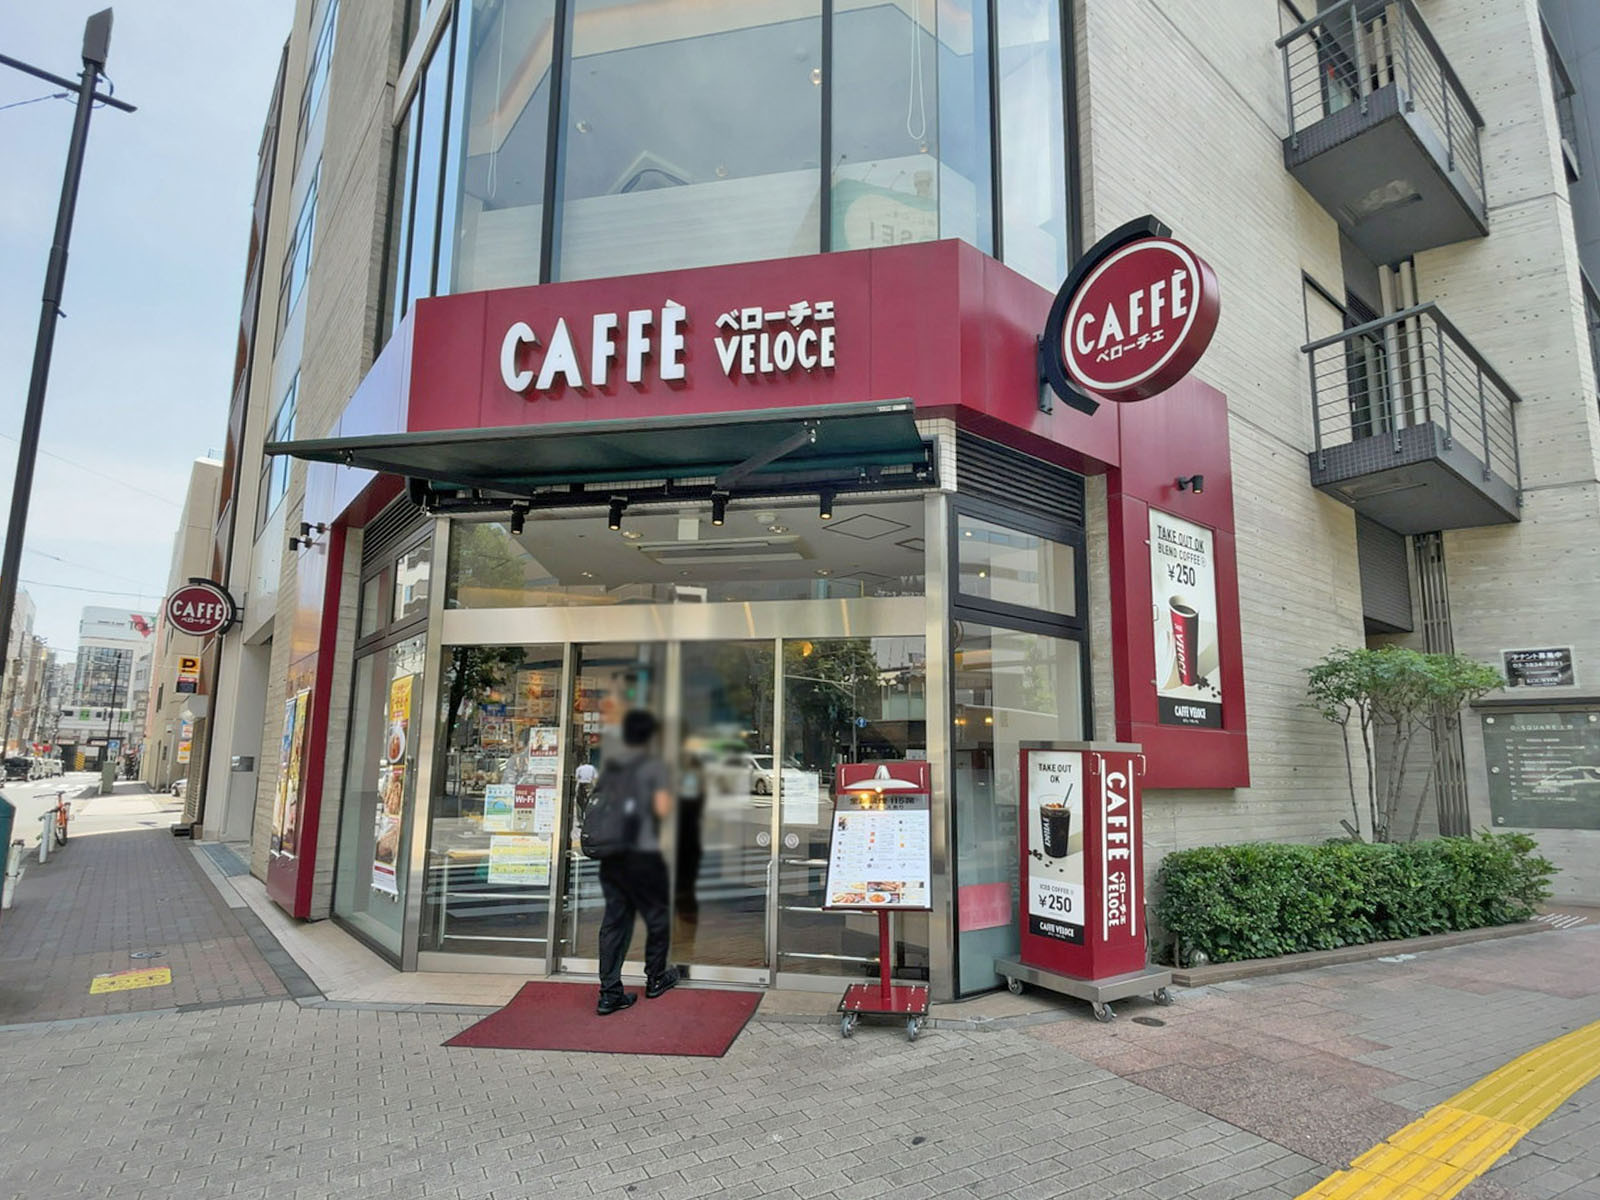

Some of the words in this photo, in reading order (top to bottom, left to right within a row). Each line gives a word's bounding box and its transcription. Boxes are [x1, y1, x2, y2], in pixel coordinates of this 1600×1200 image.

[714, 301, 835, 330] ベローチェ
[1076, 269, 1187, 355] CAFFÈ
[500, 299, 686, 393] CAFFÈ
[714, 326, 836, 376] VELOCE
[1096, 329, 1164, 362] ベローチェ
[1157, 525, 1177, 543] TAKE
[1178, 532, 1193, 549] OUT
[1194, 538, 1205, 553] OK
[1157, 542, 1178, 558] BLEND
[1179, 550, 1201, 566] COFFEE
[1167, 563, 1196, 587] ¥250
[1038, 763, 1056, 773] TAKE
[1057, 764, 1072, 774] OUT
[1050, 775, 1061, 784] OK
[515, 795, 535, 804] Wi-Fi
[1105, 771, 1130, 862] CAFFÈ
[1038, 894, 1072, 913] ¥250
[1051, 885, 1070, 895] COFFEE
[1108, 872, 1120, 927] VELOCE
[1119, 872, 1127, 925] ベローチェ
